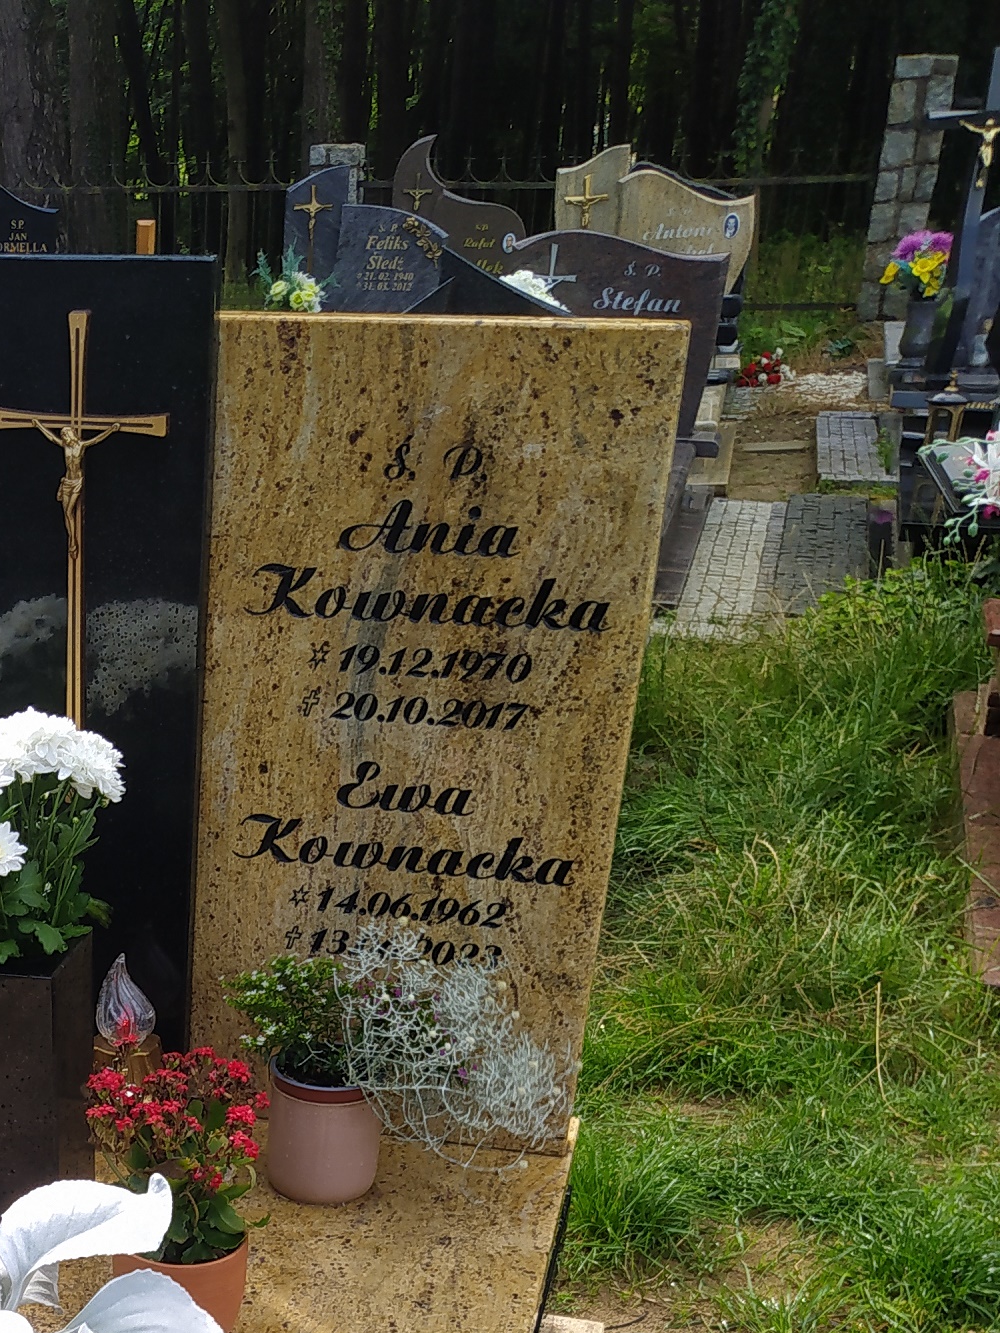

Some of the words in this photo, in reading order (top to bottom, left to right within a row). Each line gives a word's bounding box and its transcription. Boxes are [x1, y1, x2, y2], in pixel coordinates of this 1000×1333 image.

[8, 232, 28, 241] JAN
[365, 235, 410, 250] Feliks
[645, 264, 662, 277] P.
[593, 286, 682, 316] Stefan
[383, 434, 415, 481] Ś.
[443, 440, 488, 481] P.
[337, 499, 521, 559] Ania
[243, 562, 612, 634] Kownacka
[338, 644, 534, 685] 19.12.1970
[329, 691, 529, 731] 20.10.2017
[336, 761, 476, 817] Ewa
[232, 813, 577, 887] Kownacka
[314, 888, 508, 929] 14.06.1962
